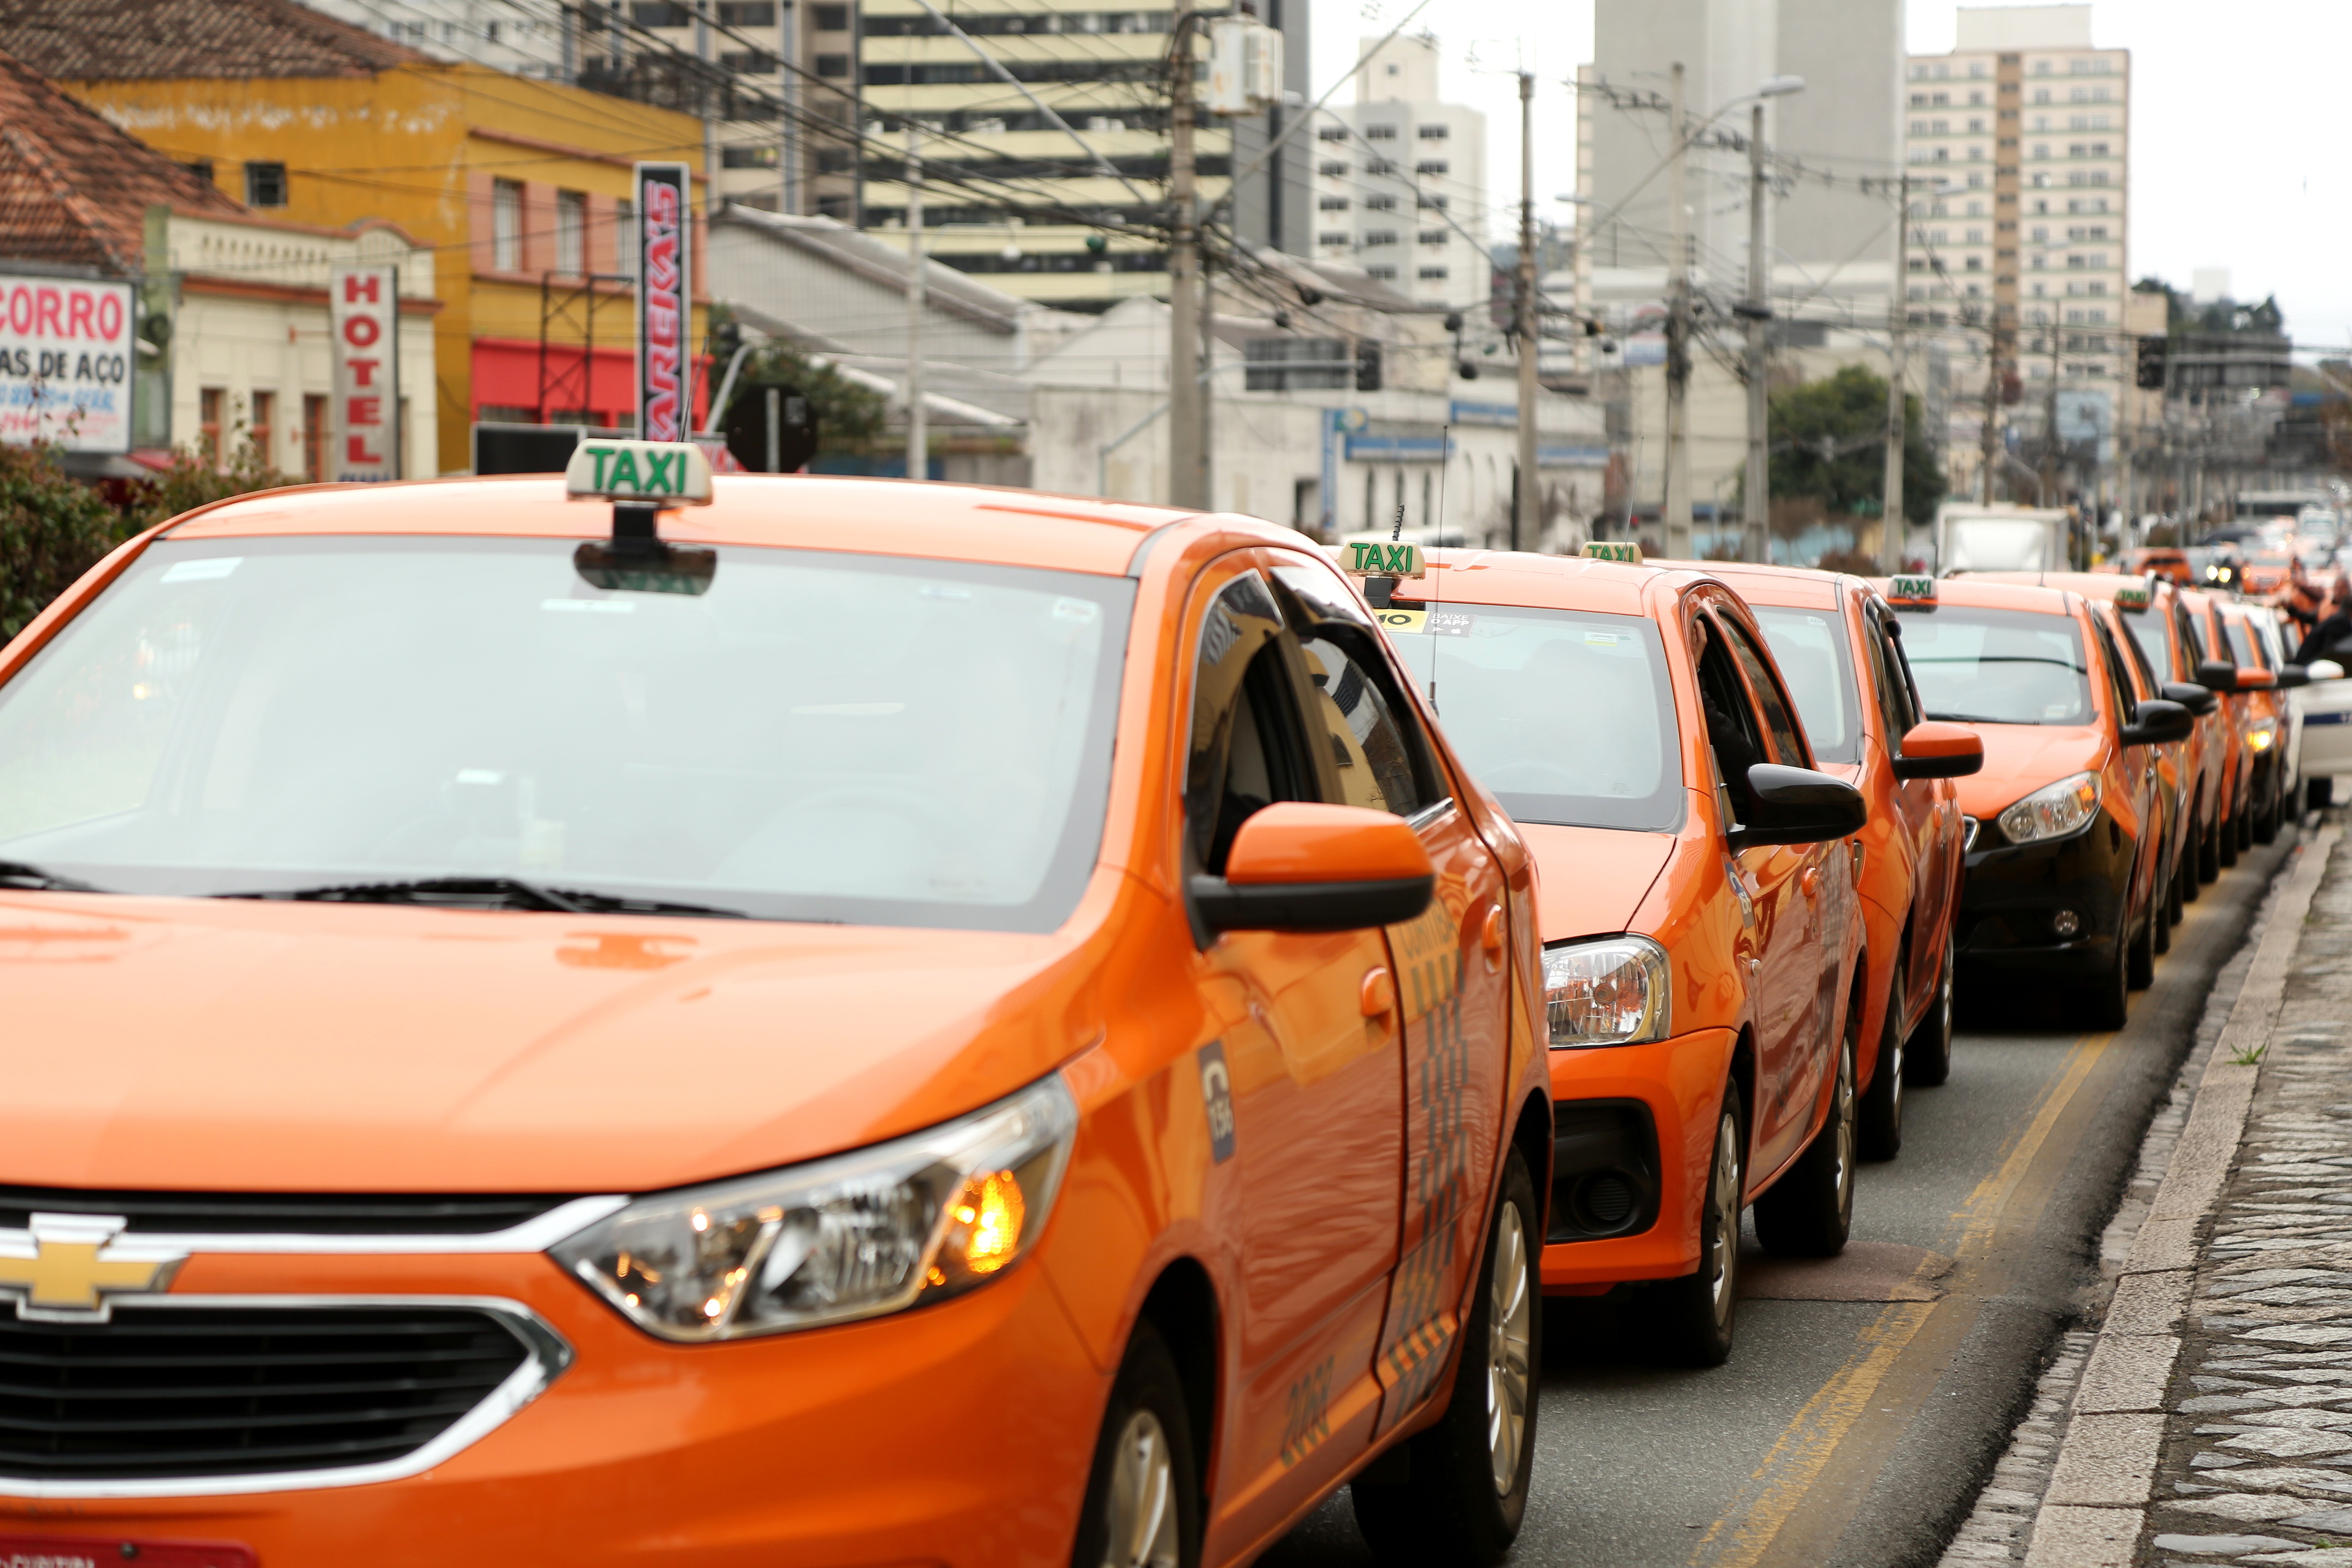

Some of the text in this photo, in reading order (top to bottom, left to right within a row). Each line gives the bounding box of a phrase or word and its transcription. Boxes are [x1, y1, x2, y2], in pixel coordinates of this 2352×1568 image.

[0, 285, 123, 341] ORRO
[39, 350, 66, 379] DE
[76, 354, 124, 385] AÇO
[345, 275, 382, 464] HOTEL
[586, 449, 686, 493] TAXI
[1351, 543, 1413, 572] TAXI
[1588, 545, 1634, 563] TAXI
[1895, 578, 1932, 594] TAXI
[2120, 590, 2146, 603] TAXI
